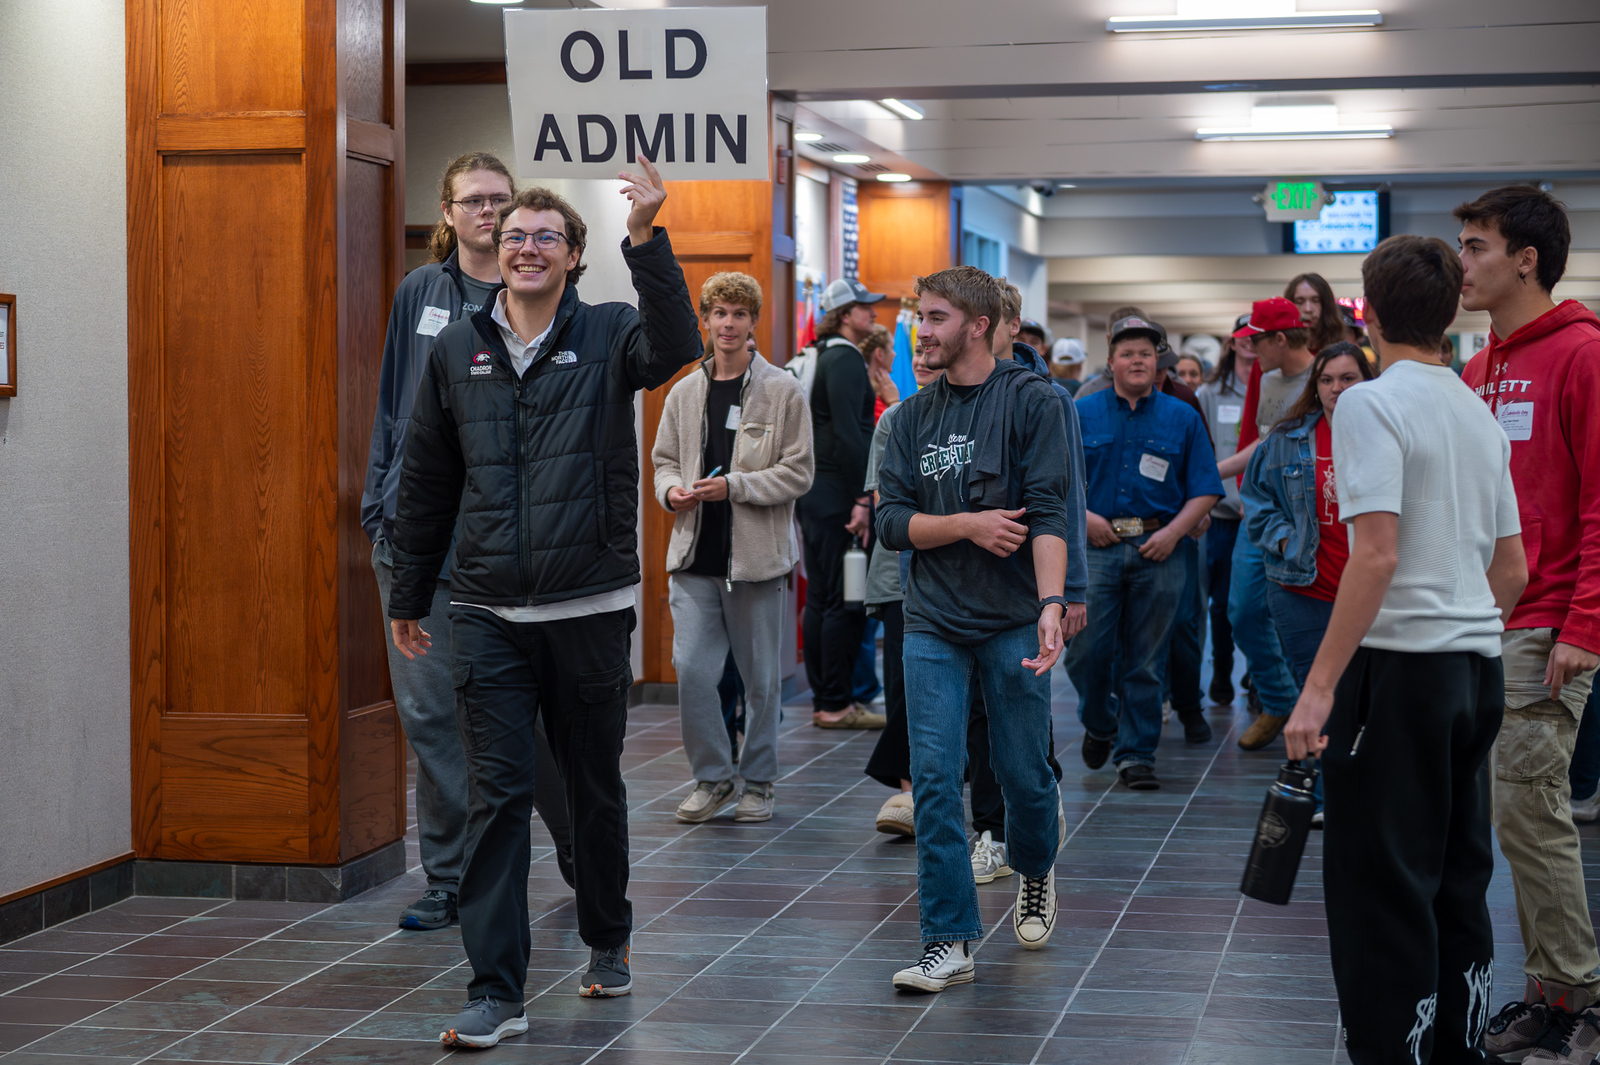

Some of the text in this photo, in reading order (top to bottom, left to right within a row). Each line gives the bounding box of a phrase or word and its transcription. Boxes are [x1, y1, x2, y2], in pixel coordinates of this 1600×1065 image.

[560, 29, 708, 83] OLD
[533, 113, 748, 165] ADMIN
[1277, 182, 1315, 210] EXIT
